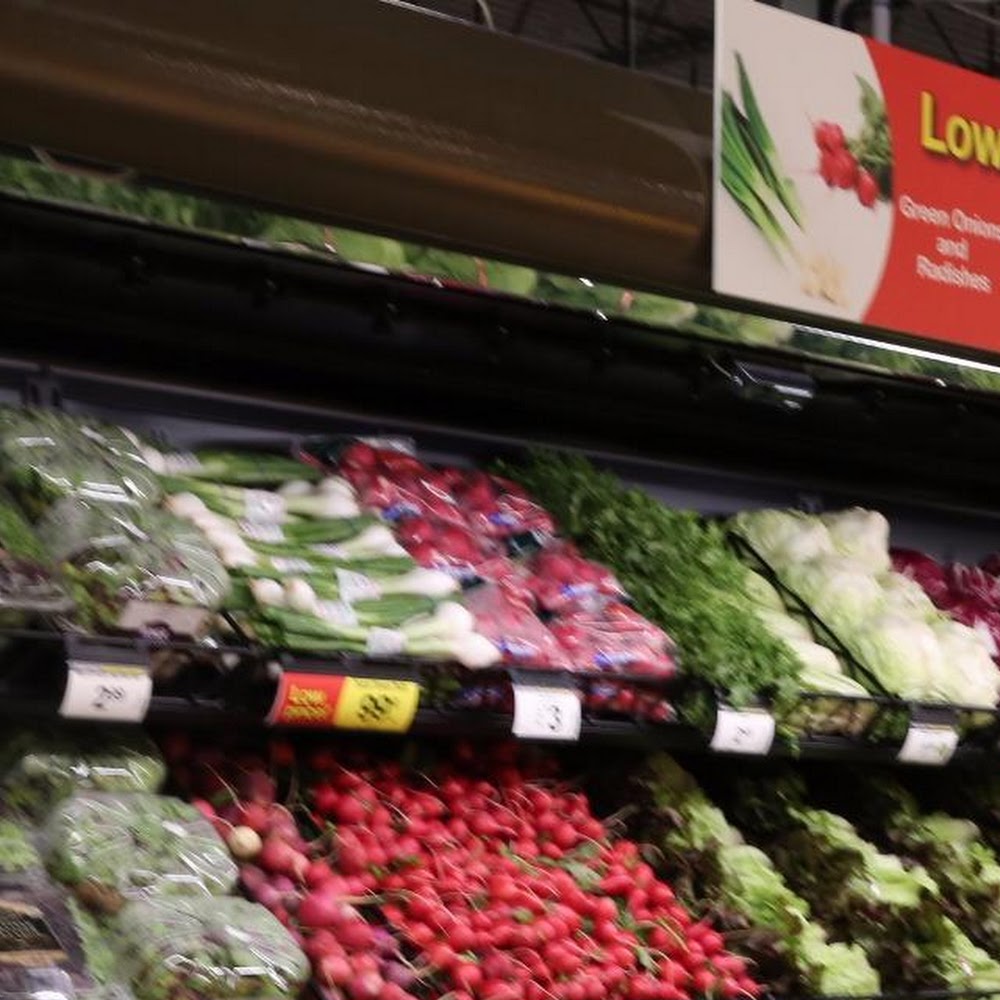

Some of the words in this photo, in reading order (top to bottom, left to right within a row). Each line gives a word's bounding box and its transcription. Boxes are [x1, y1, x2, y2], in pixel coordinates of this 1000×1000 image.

[900, 195, 950, 228] Green
[936, 237, 969, 261] and
[916, 253, 992, 294] Radishes
